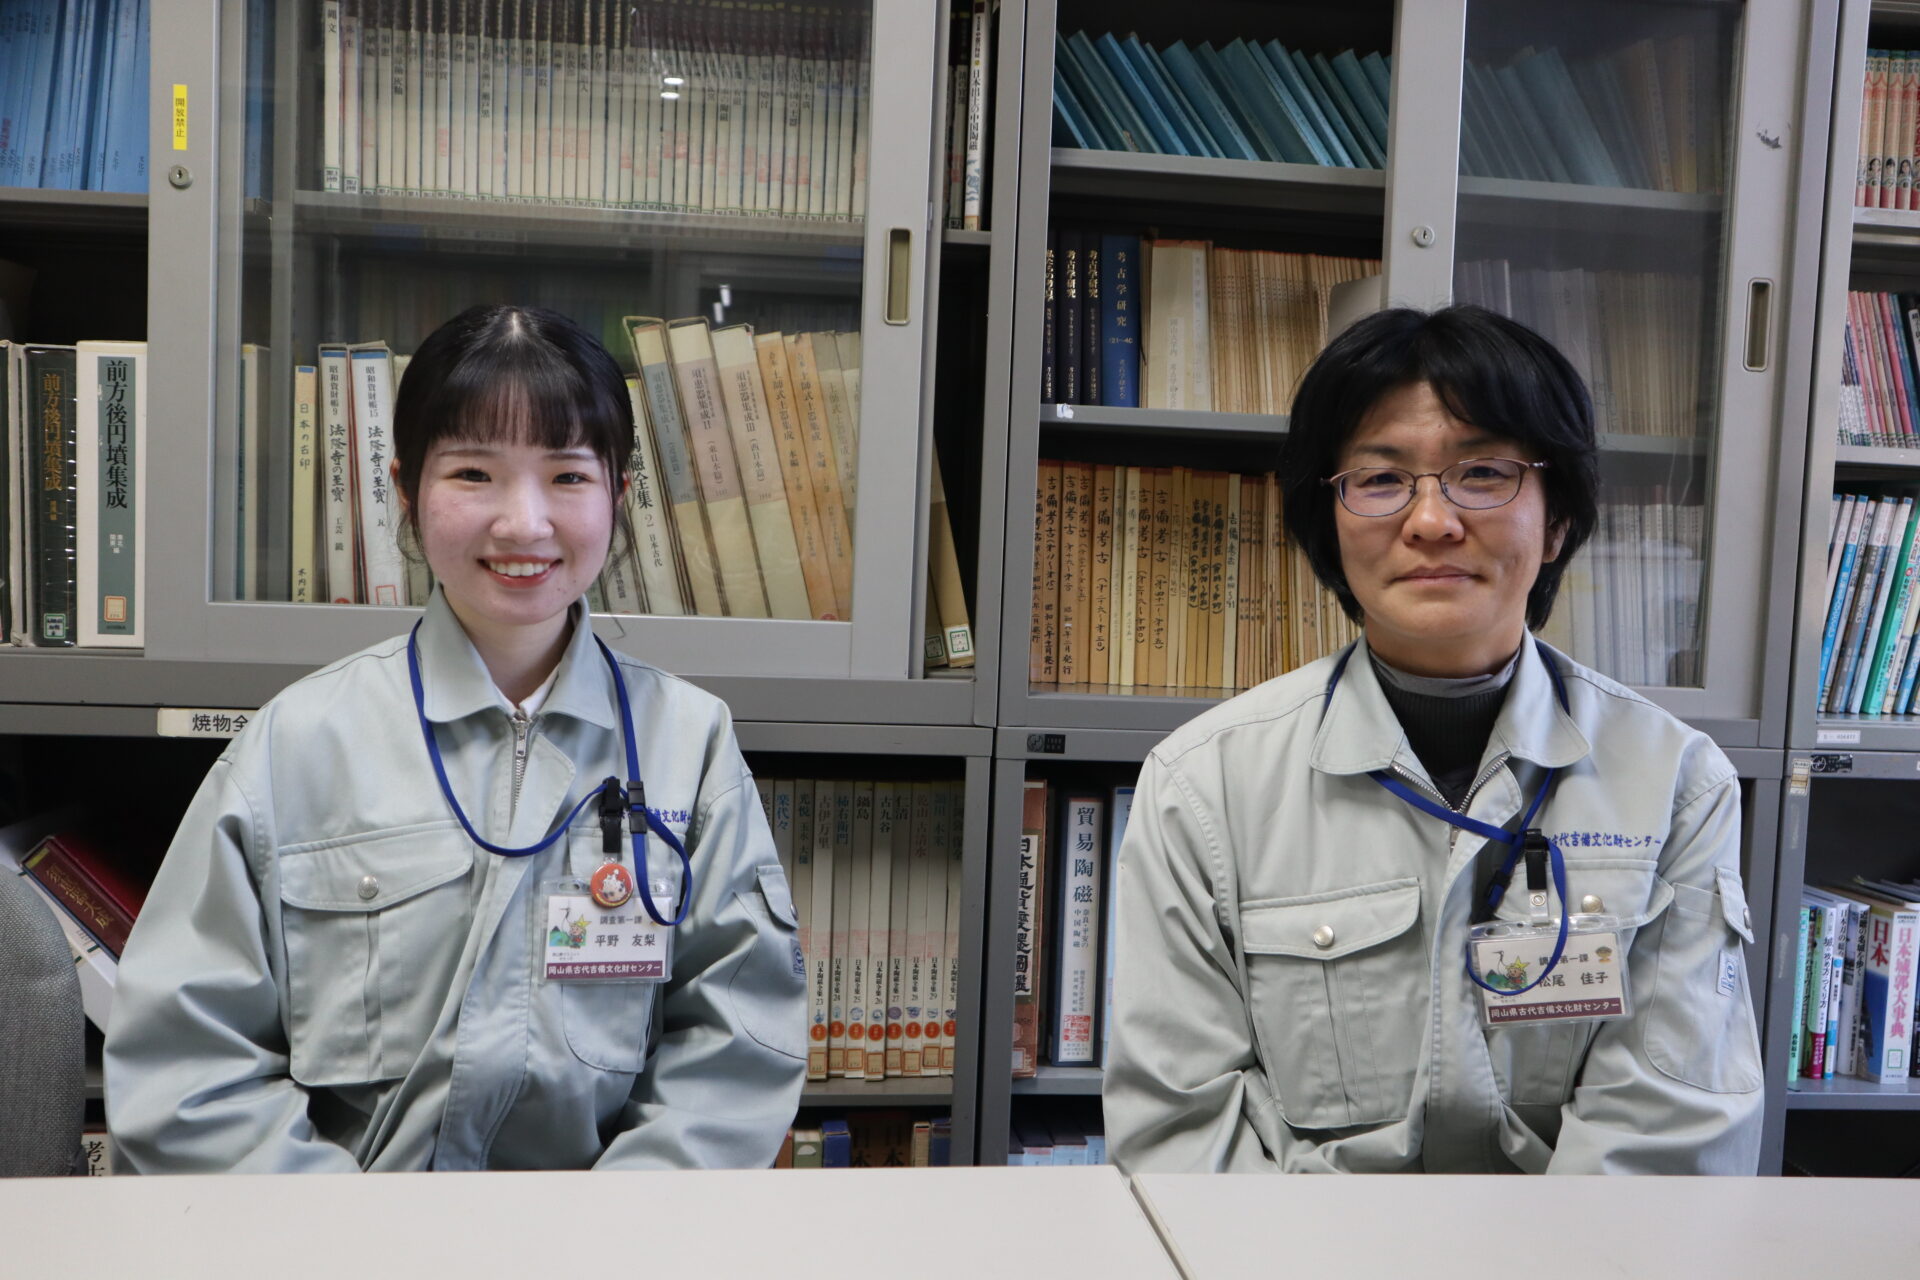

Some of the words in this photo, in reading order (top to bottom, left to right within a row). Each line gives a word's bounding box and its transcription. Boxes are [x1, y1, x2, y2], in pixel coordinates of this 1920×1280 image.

[175, 97, 186, 139] 開放禁止
[1116, 251, 1127, 327] 考古学研究
[43, 373, 63, 492] 前方後円墳集成
[105, 360, 128, 510] 前方後円墳集成
[298, 403, 311, 470] 日本の古印
[643, 513, 655, 529] 2
[1045, 476, 1058, 537] 吉備考古
[1064, 475, 1077, 535] 吉備考古
[1079, 475, 1090, 537] 吉備考古
[1096, 486, 1111, 564] 吉備考古
[1138, 488, 1151, 559] 吉備考古
[1154, 489, 1169, 563] 吉備考古
[648, 532, 663, 568] 日本古代
[776, 793, 790, 831] 楽代々
[818, 795, 831, 848] 古伊万里
[836, 794, 849, 846] 柿右衛門
[856, 795, 870, 821] 鍋島
[879, 795, 892, 834] 古九谷
[1072, 806, 1095, 904] 貿易陶磁
[594, 934, 619, 948] 平野
[600, 915, 643, 925] 調査第一課
[1871, 919, 1890, 968] 日本
[548, 963, 661, 976] 岡山県古代吉備文化財センター
[875, 960, 883, 997] 日本陶磁全集
[930, 957, 938, 993] 日本陶磁全集
[1538, 974, 1566, 988] 松尾
[1580, 971, 1608, 985] 佳子
[1890, 927, 1913, 1039] 日本城郭大事典
[1491, 1001, 1620, 1019] 岡山県古代吉備文化財センター
